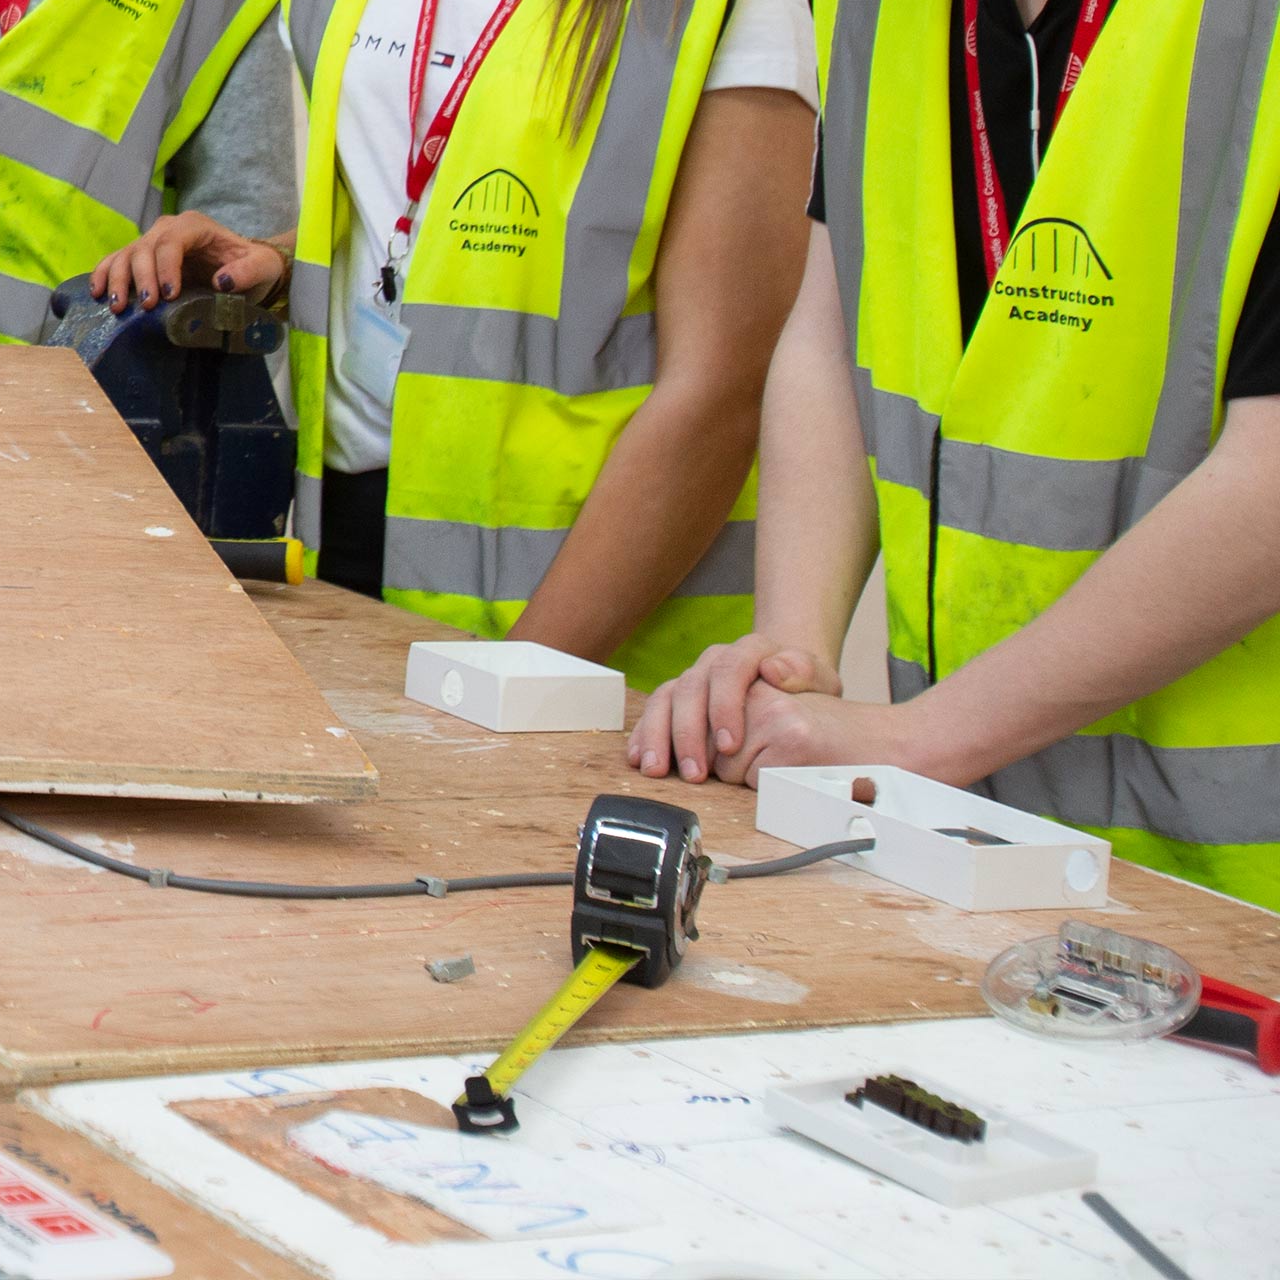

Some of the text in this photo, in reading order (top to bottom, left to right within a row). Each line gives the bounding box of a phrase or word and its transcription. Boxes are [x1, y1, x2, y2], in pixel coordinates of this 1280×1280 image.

[974, 90, 987, 132] Student
[978, 131, 994, 197] Construction
[449, 219, 538, 239] Construction
[987, 197, 1000, 237] College
[461, 239, 527, 257] Academy
[994, 280, 1115, 306] Construction
[1008, 305, 1093, 332] Academy
